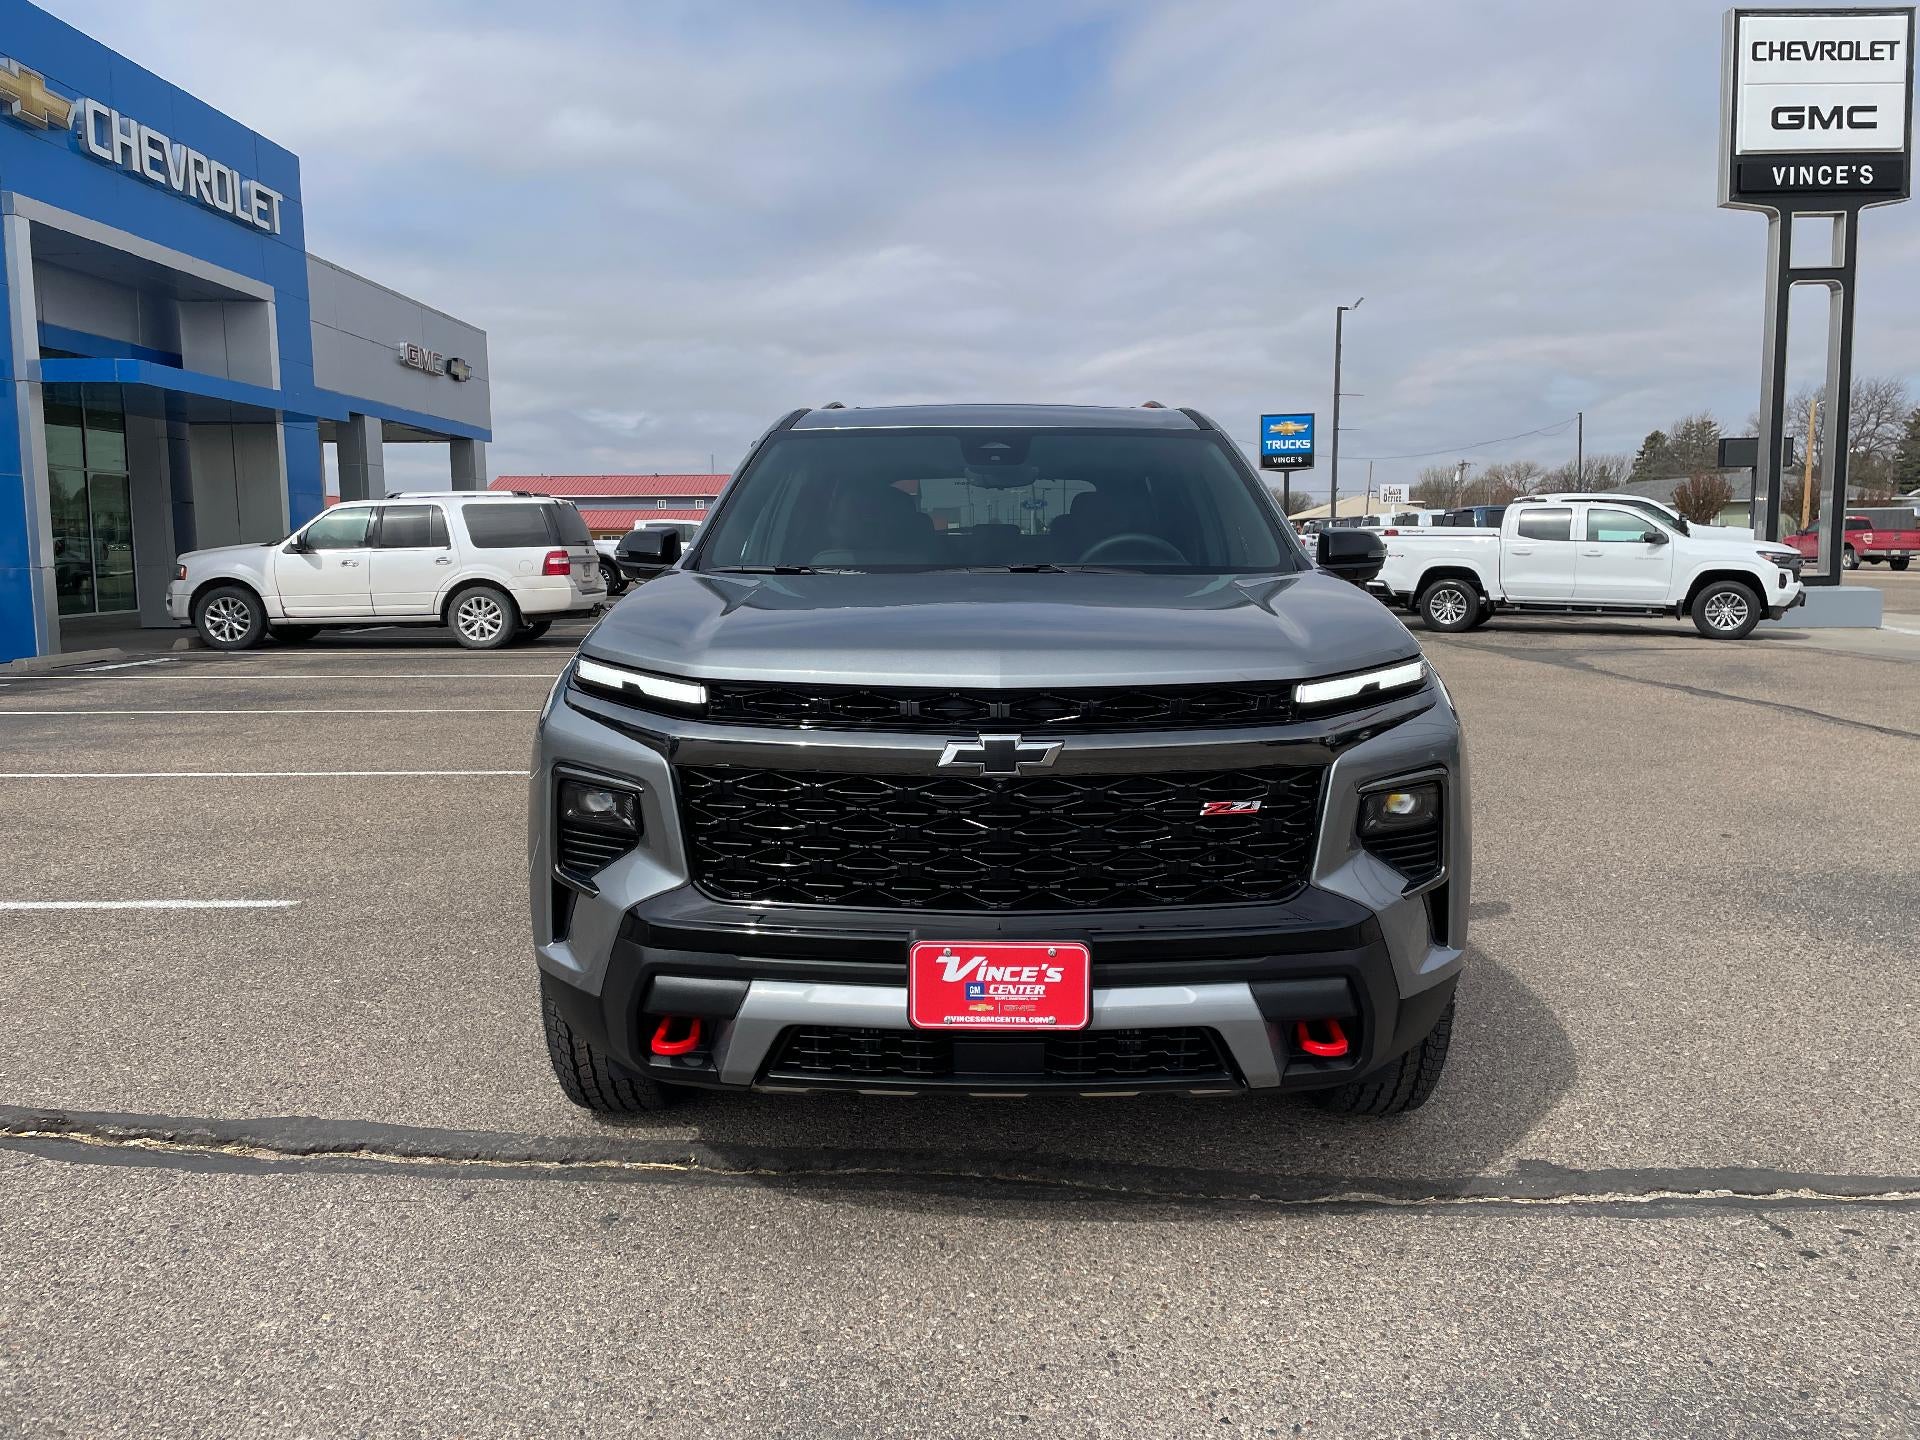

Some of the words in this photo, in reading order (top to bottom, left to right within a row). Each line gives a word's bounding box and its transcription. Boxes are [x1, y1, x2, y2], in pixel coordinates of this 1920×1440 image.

[1751, 40, 1900, 61] CHEVROLET
[1771, 105, 1878, 130] GMC
[79, 97, 283, 235] CHEVROLET
[1772, 165, 1874, 186] VINCE'S
[401, 341, 445, 376] GMC
[1265, 440, 1311, 450] TRUCKS
[1272, 456, 1303, 464] VINCE'S
[1199, 800, 1262, 816] Z71
[969, 985, 981, 994] GM
[988, 984, 1046, 995] CENTER
